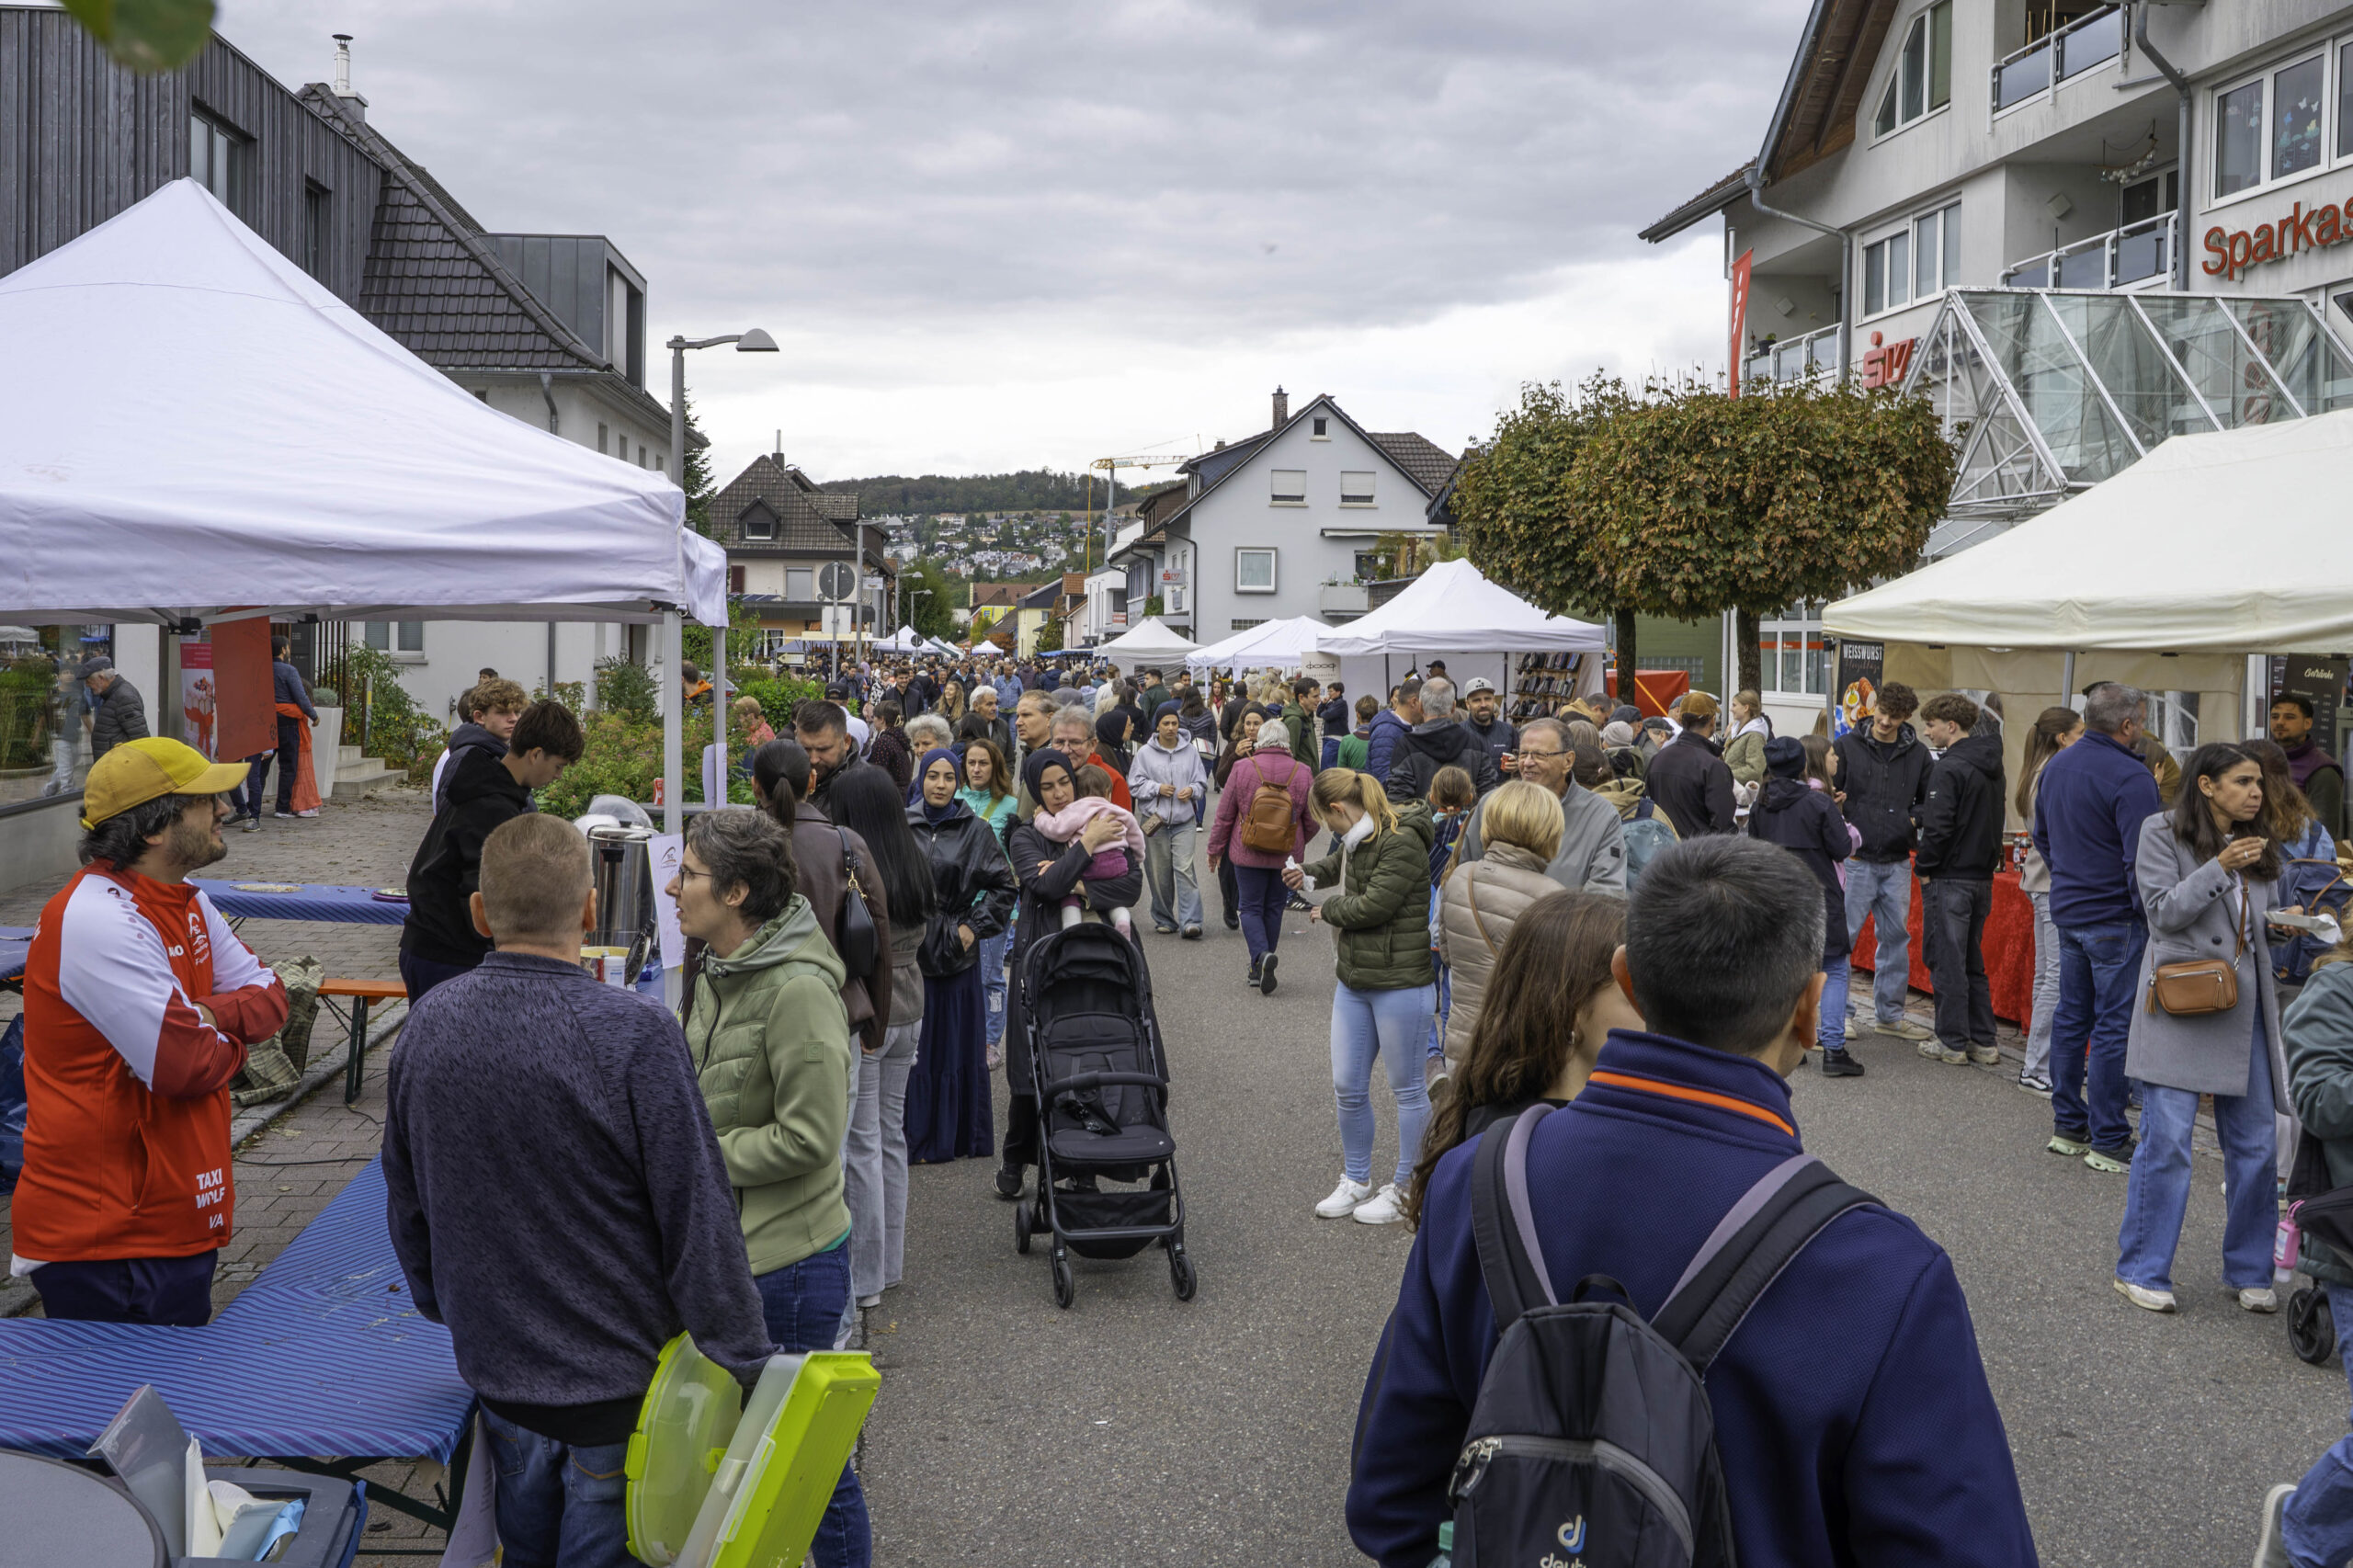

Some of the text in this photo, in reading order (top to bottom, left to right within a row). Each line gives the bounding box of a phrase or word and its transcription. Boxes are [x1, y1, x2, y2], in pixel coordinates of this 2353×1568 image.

[1843, 643, 1883, 661] WEISSWURST
[2303, 667, 2335, 680] Getränke
[196, 1167, 222, 1190] TAXI
[195, 1186, 226, 1210] WOLF
[209, 1212, 224, 1230] VA
[1540, 1551, 1587, 1568] deut
